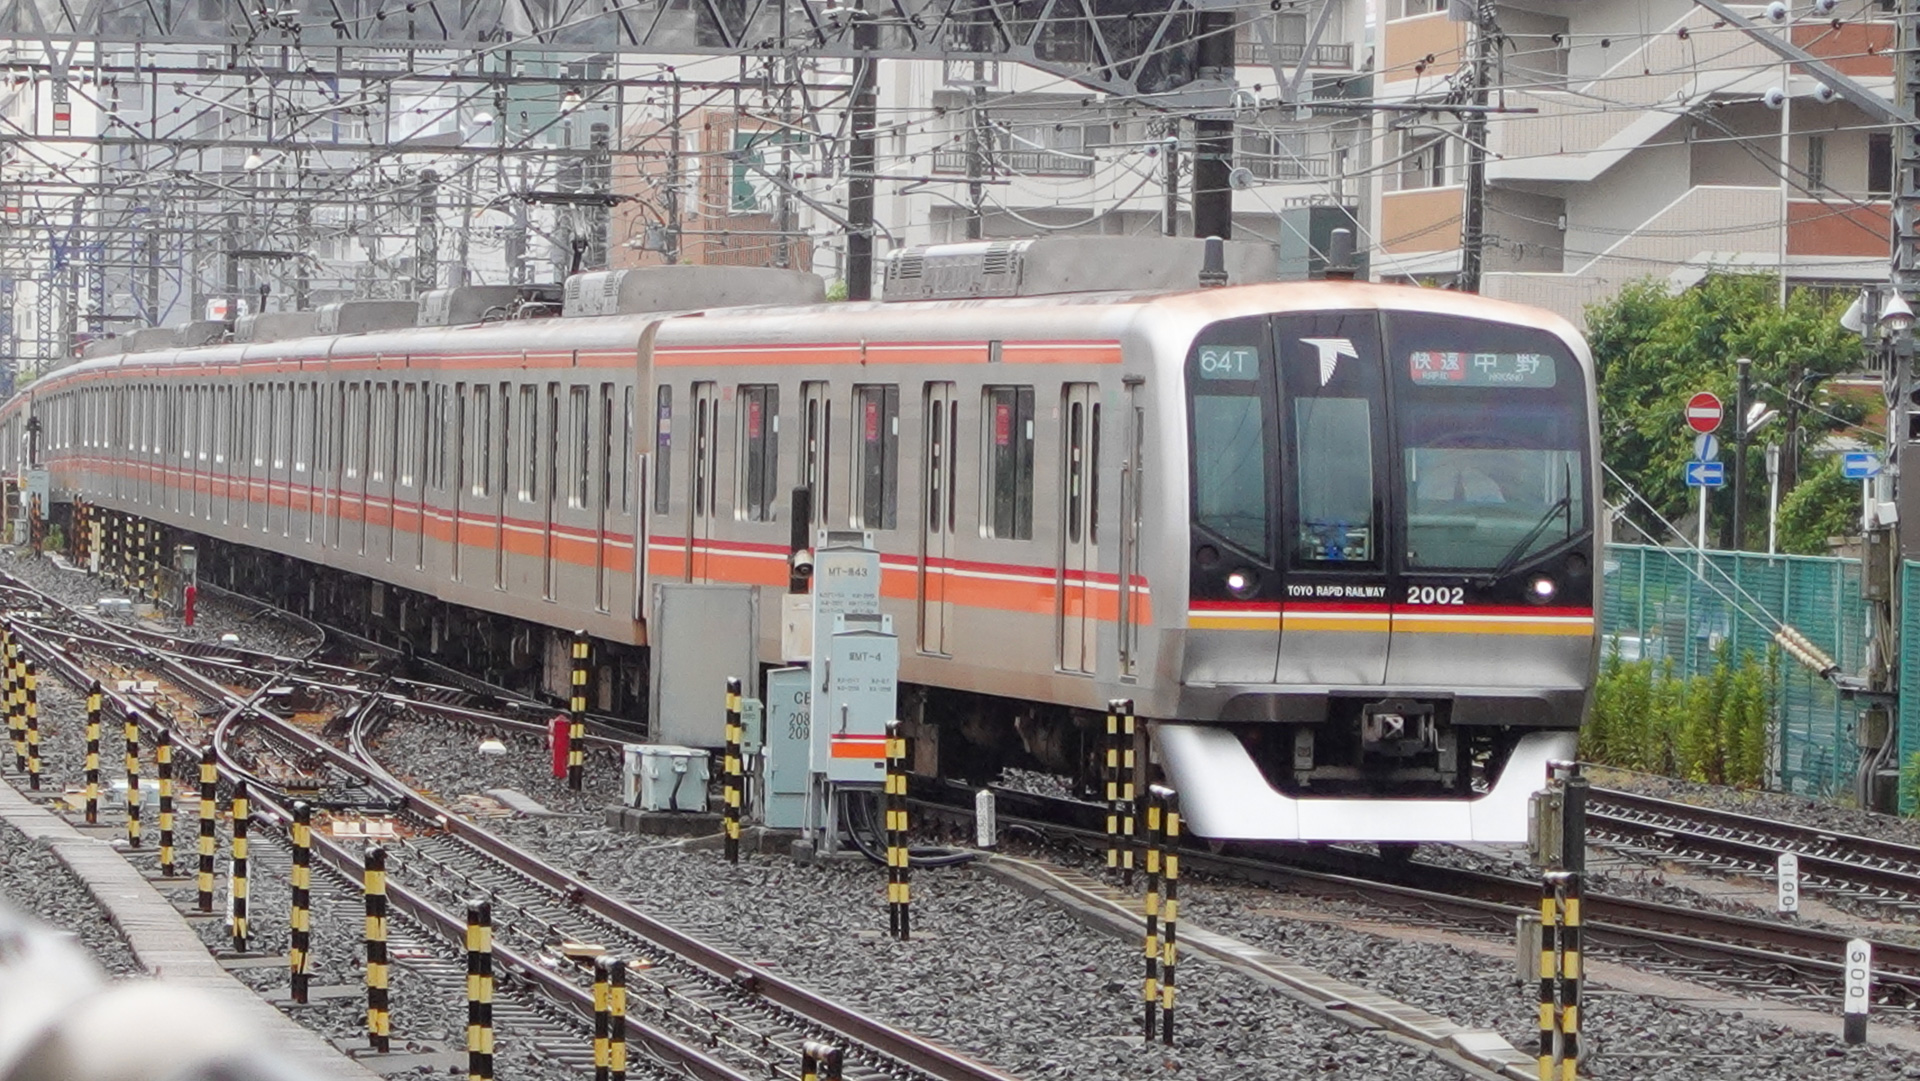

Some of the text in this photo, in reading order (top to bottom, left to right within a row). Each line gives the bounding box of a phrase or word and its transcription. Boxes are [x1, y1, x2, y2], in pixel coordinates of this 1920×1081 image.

[1202, 350, 1249, 372] 64T
[1411, 351, 1461, 370] 快速
[1474, 353, 1541, 375] 中野
[1287, 585, 1386, 598] TOYO RAPID RAILWAY
[1407, 586, 1464, 605] 2002
[789, 712, 811, 726] 208
[788, 726, 810, 740] 209
[1850, 951, 1867, 998] 500
